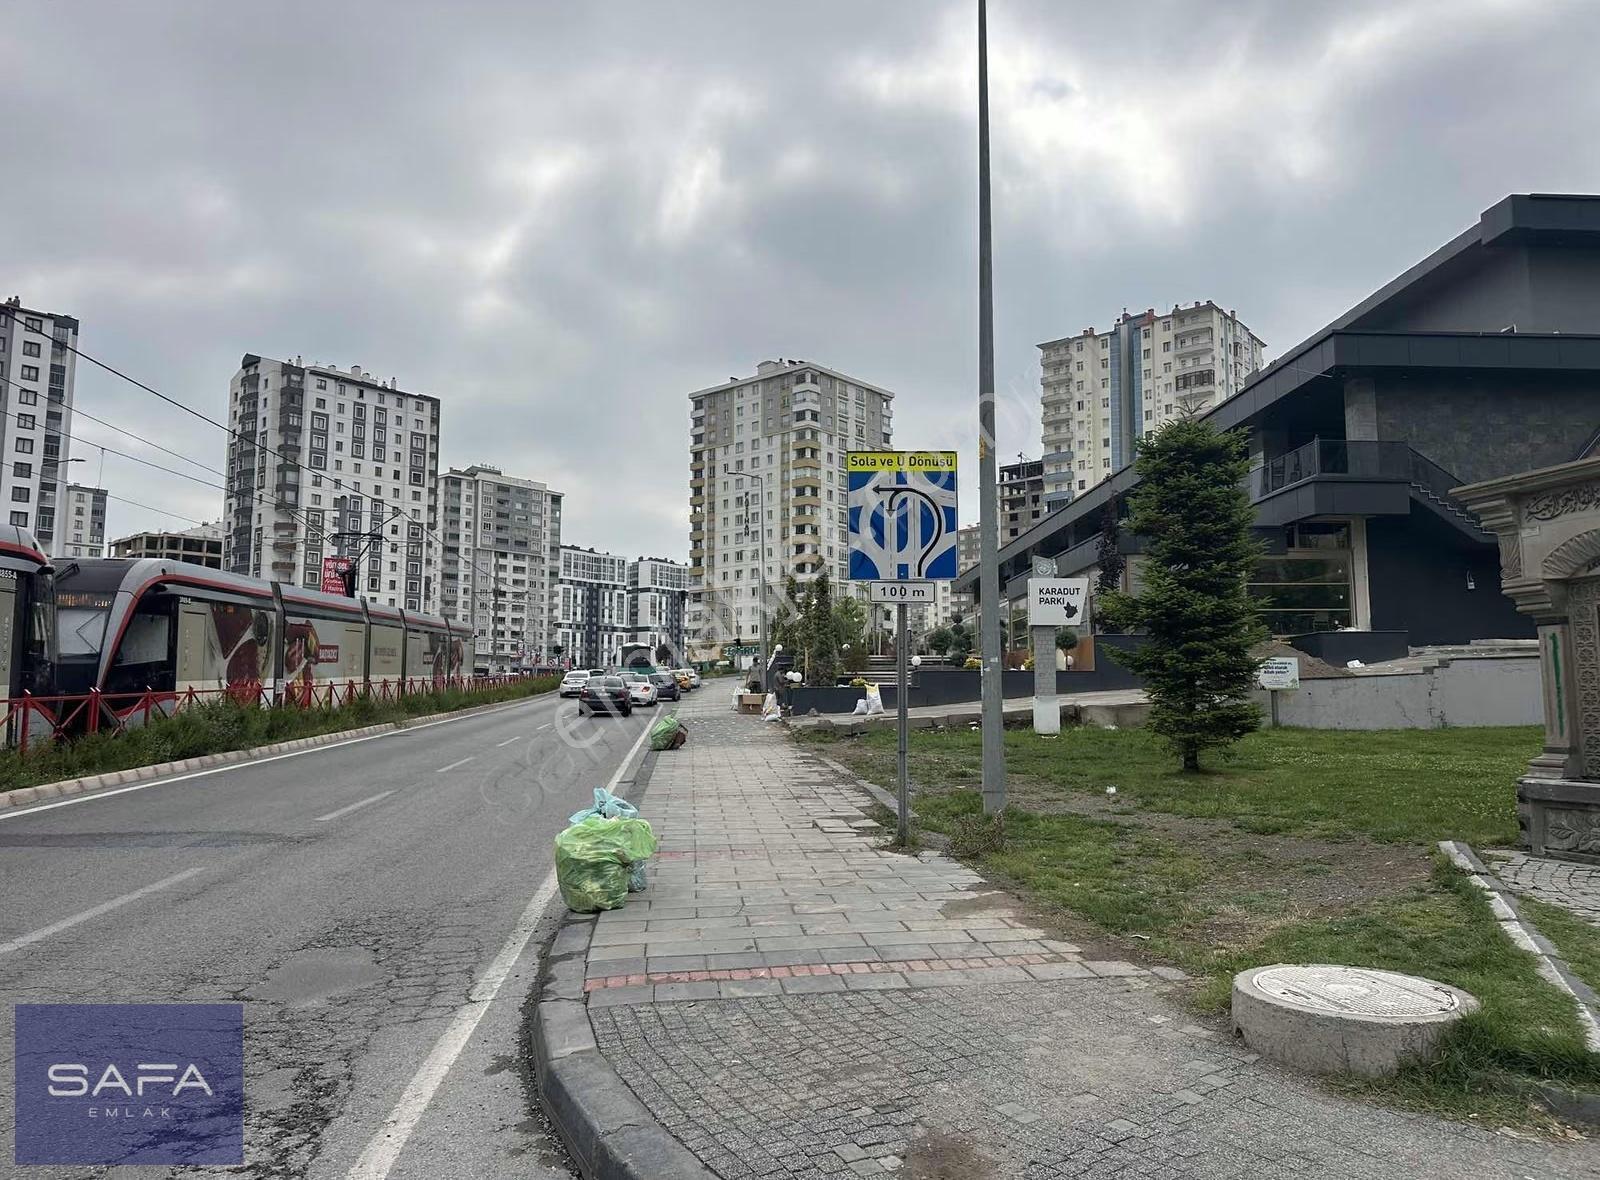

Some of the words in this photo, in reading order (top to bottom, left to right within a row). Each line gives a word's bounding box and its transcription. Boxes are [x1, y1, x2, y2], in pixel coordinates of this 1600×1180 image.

[850, 456, 877, 467] Sola
[880, 458, 893, 467] ve
[908, 455, 953, 469] Dönüşü
[880, 586, 907, 597] 100
[912, 588, 925, 597] m
[1038, 587, 1081, 596] KARADUT
[1038, 596, 1066, 606] PARKI
